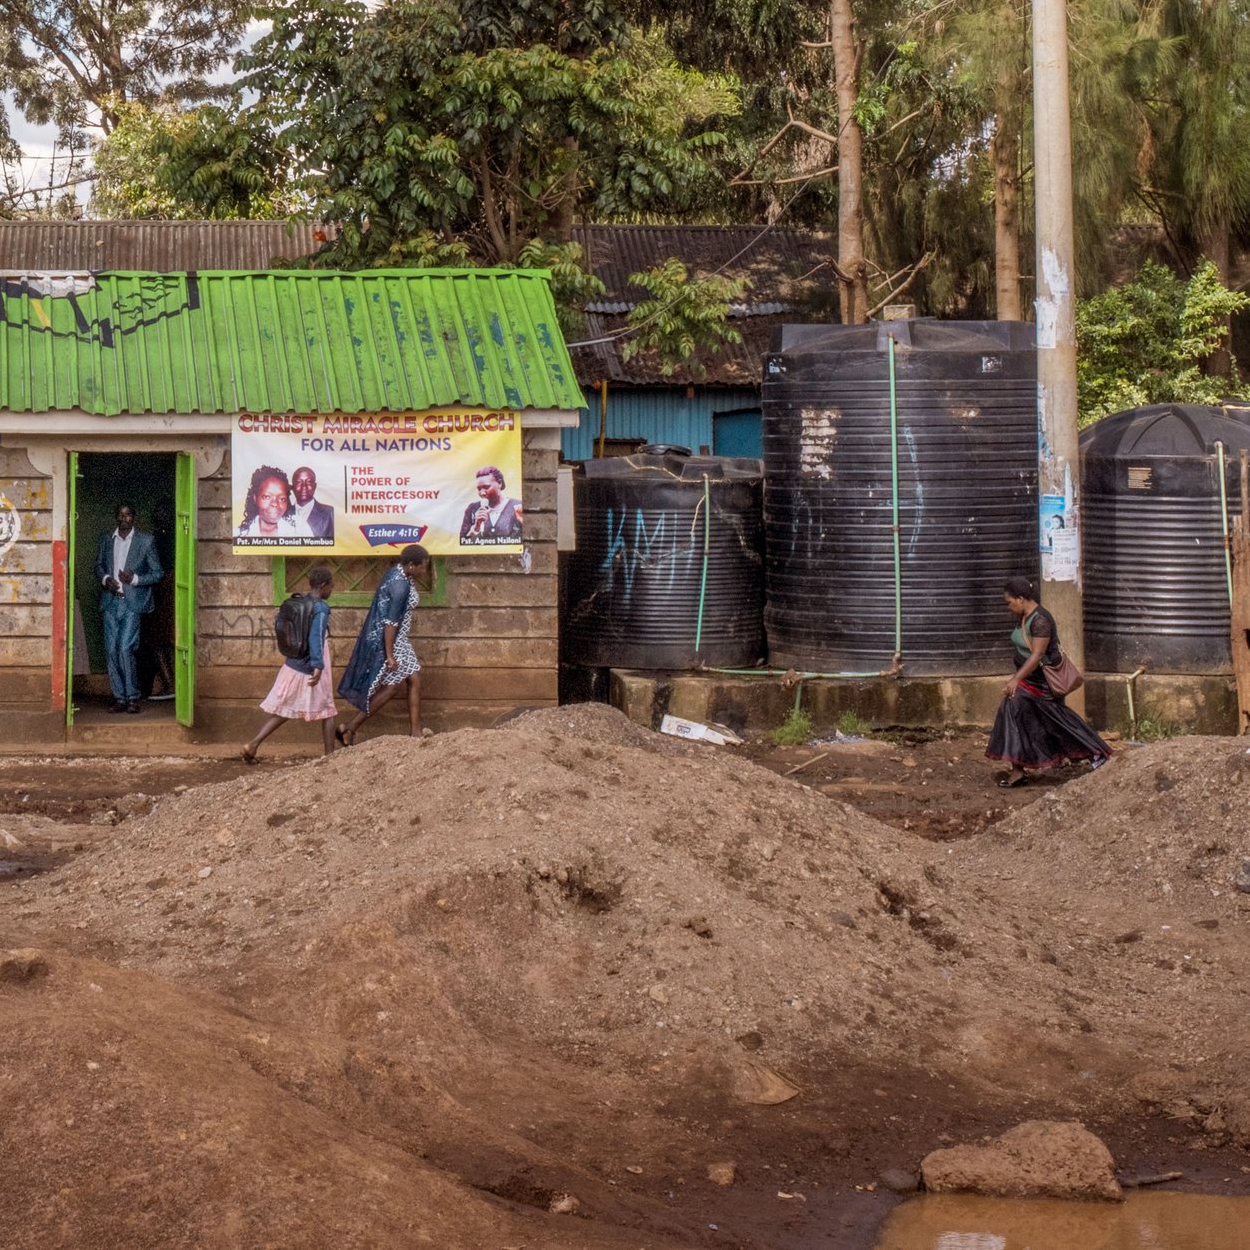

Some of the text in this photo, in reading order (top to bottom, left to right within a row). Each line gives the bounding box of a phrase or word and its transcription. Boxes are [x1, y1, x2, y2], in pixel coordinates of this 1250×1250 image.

[238, 412, 515, 435] CHRIST MIRACLE CHURCH
[301, 437, 452, 452] FOR ALL NATIONS
[351, 466, 374, 475] THE
[351, 477, 410, 486] POWER OF
[351, 490, 440, 500] INTERCCESORY
[351, 504, 407, 514] MINISTRY
[368, 528, 419, 537] Esther 4:16
[237, 538, 250, 546] Pst.
[252, 537, 277, 546] Mr/Mrs
[279, 537, 301, 546] Daniel
[475, 537, 496, 546] Agnes
